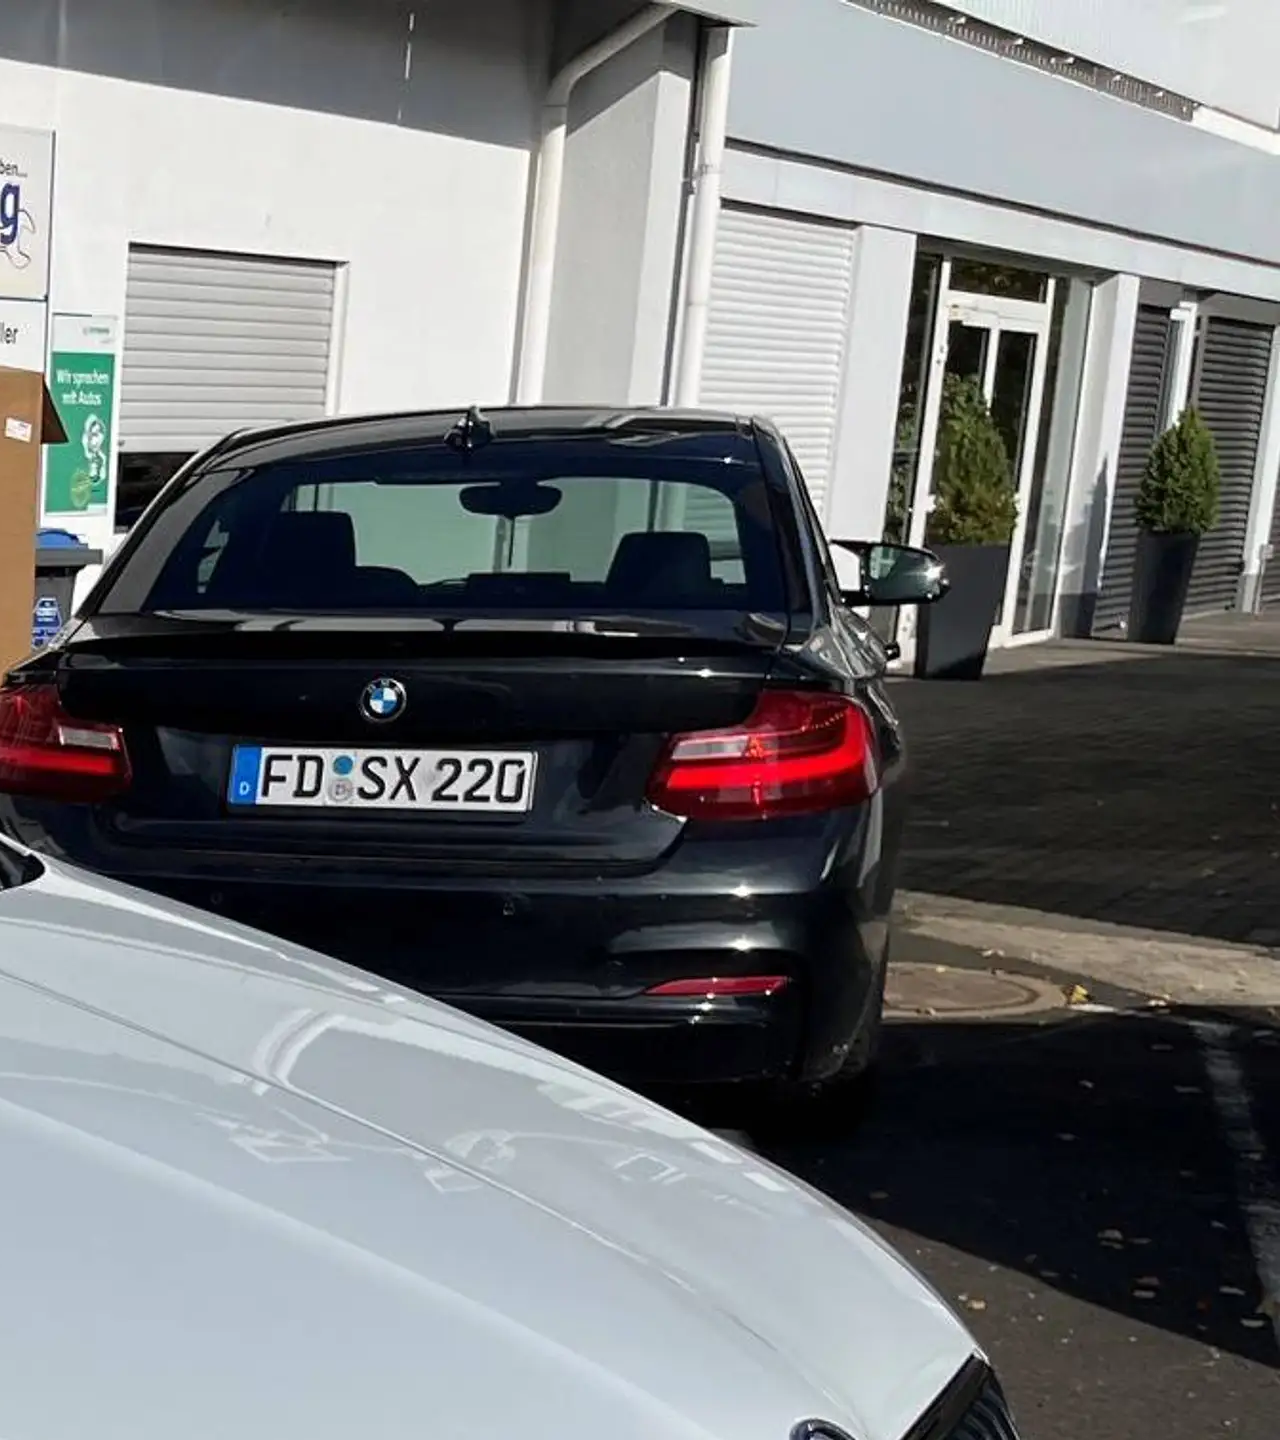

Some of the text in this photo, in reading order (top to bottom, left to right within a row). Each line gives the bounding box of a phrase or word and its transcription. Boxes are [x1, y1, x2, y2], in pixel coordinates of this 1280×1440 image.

[56, 369, 71, 385] Wir
[262, 755, 527, 803] FD SX 220
[238, 782, 251, 796] D
